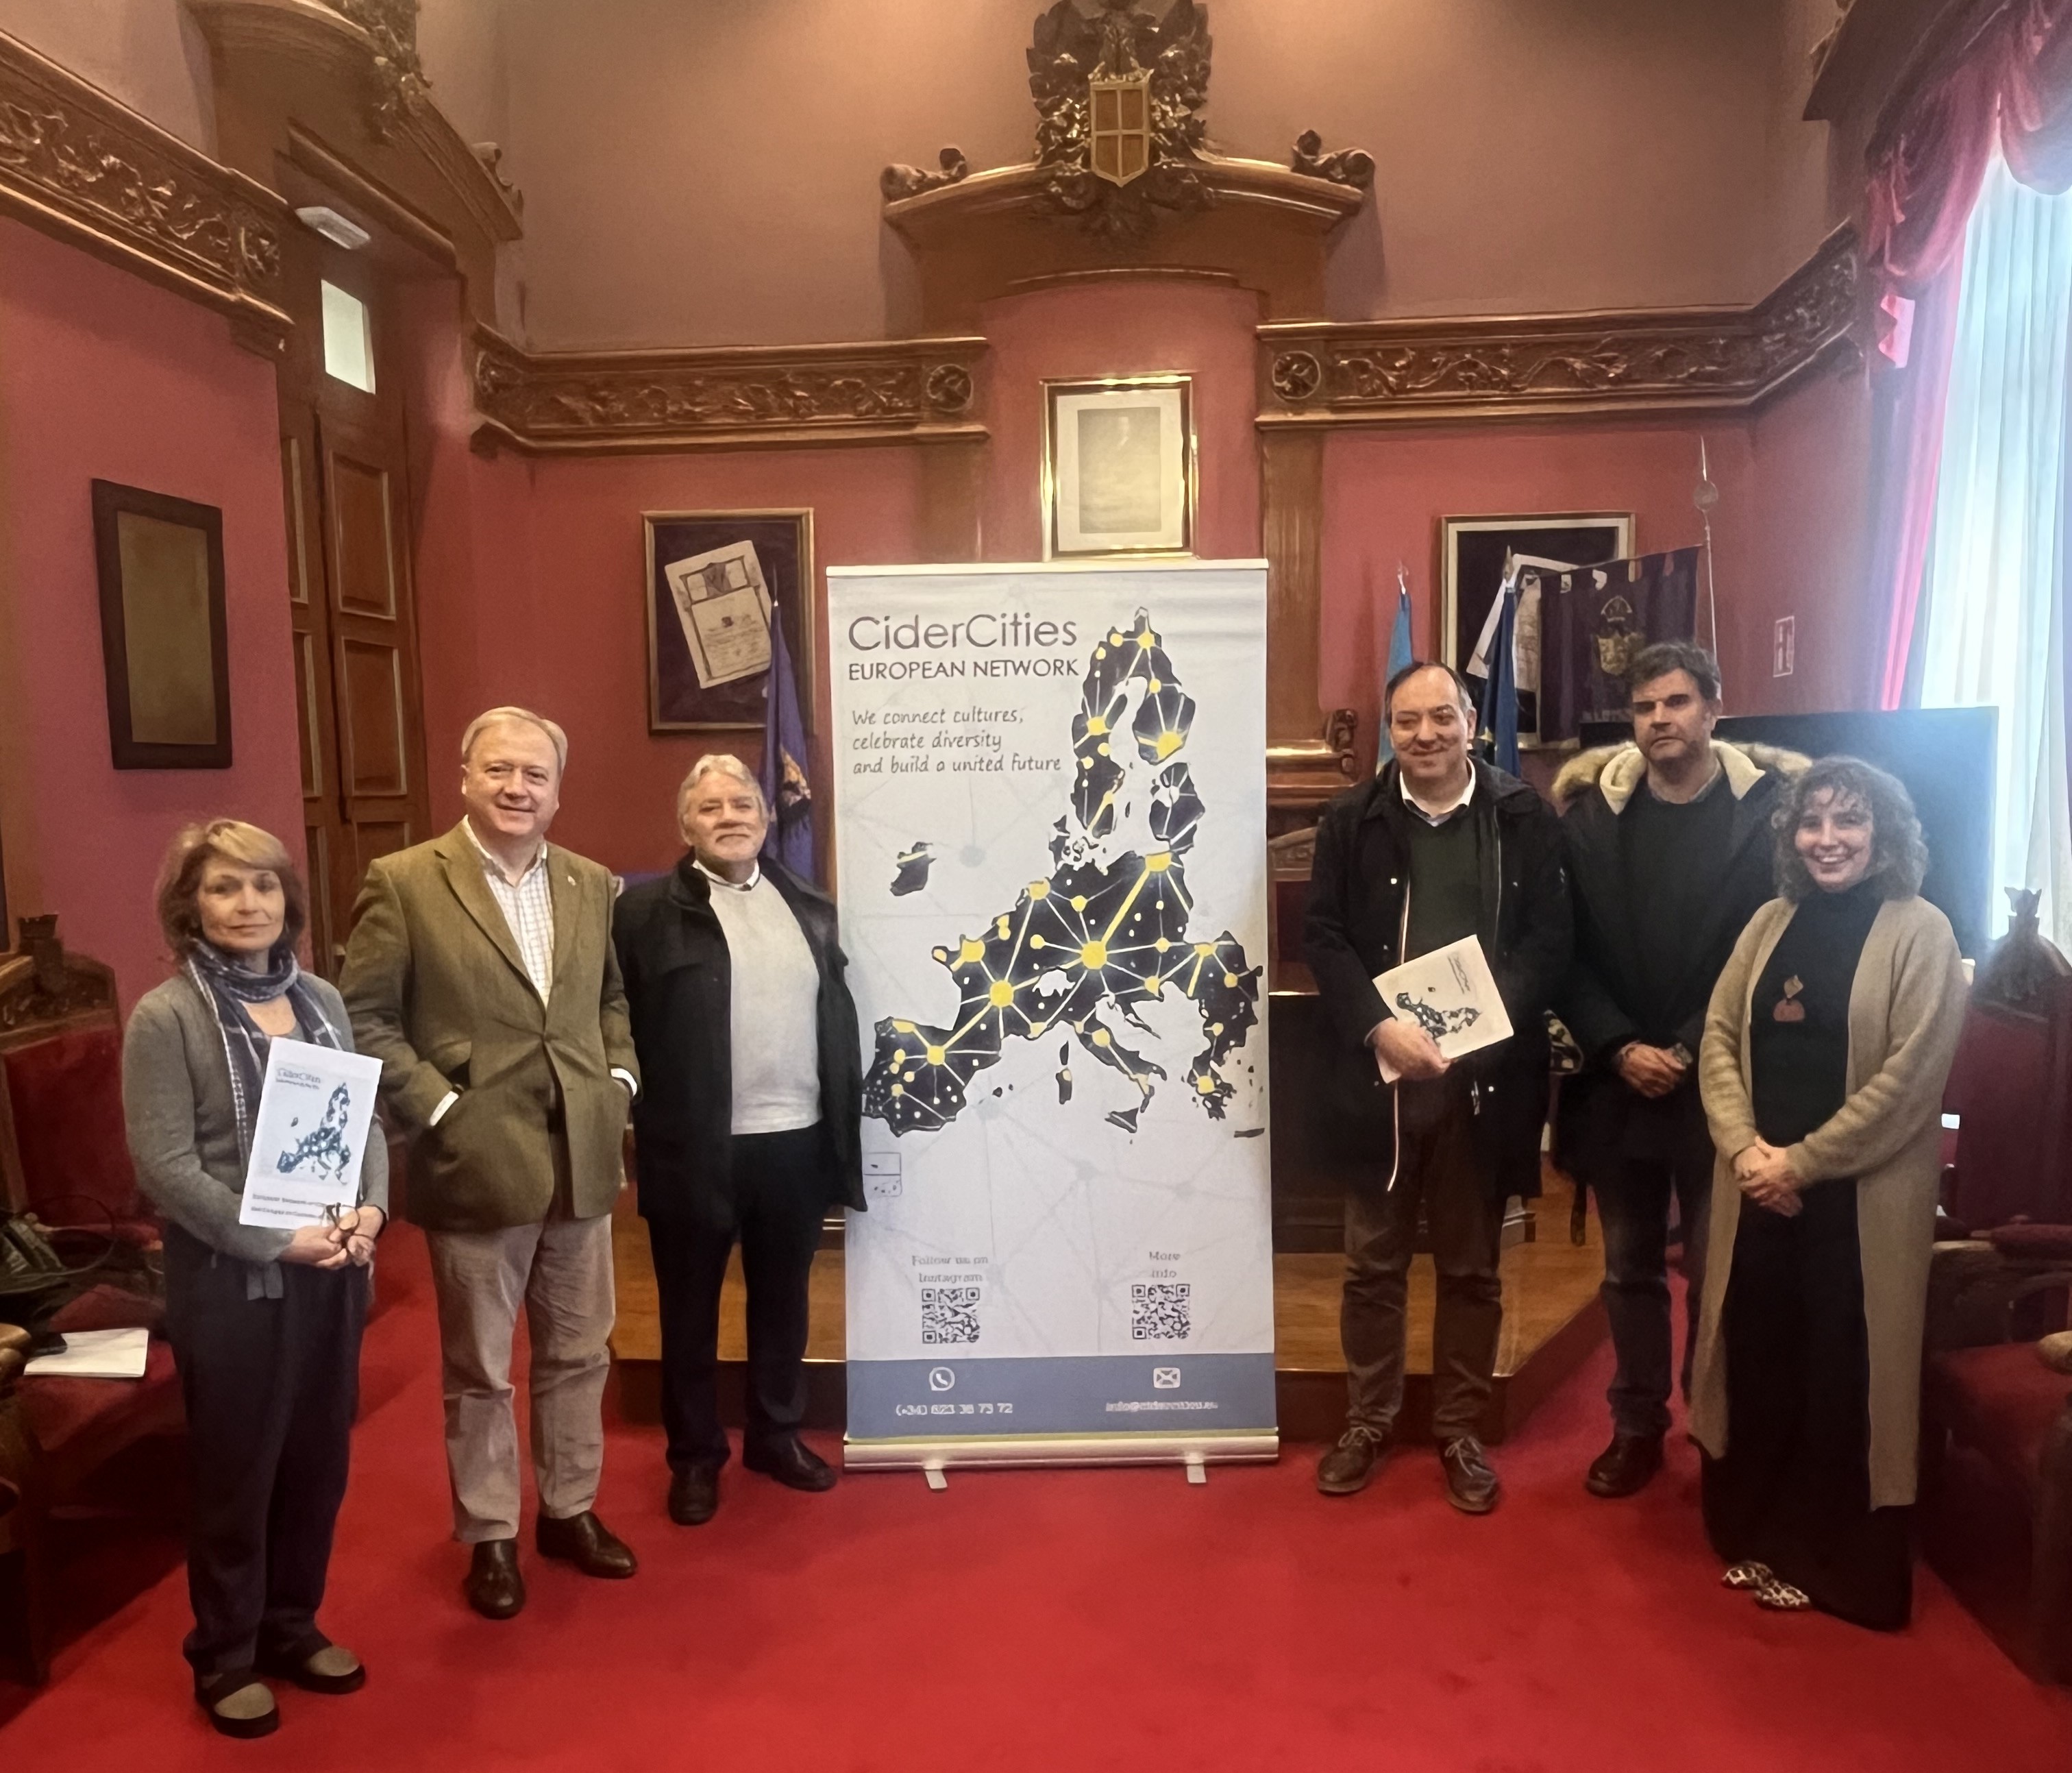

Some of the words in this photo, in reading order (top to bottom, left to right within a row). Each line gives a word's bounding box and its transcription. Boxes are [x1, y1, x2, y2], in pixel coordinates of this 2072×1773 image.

[848, 611, 1077, 651] CiderCities
[848, 660, 965, 681] EUROPEAN
[973, 658, 1079, 678] NETWORK
[852, 709, 876, 725] We
[883, 708, 946, 725] connect
[953, 705, 1024, 724] cultures,
[852, 730, 925, 750] celebrate
[931, 729, 1002, 753] diversity
[852, 756, 883, 774] and
[890, 755, 930, 774] build
[952, 755, 1004, 772] united
[1011, 753, 1061, 772] future
